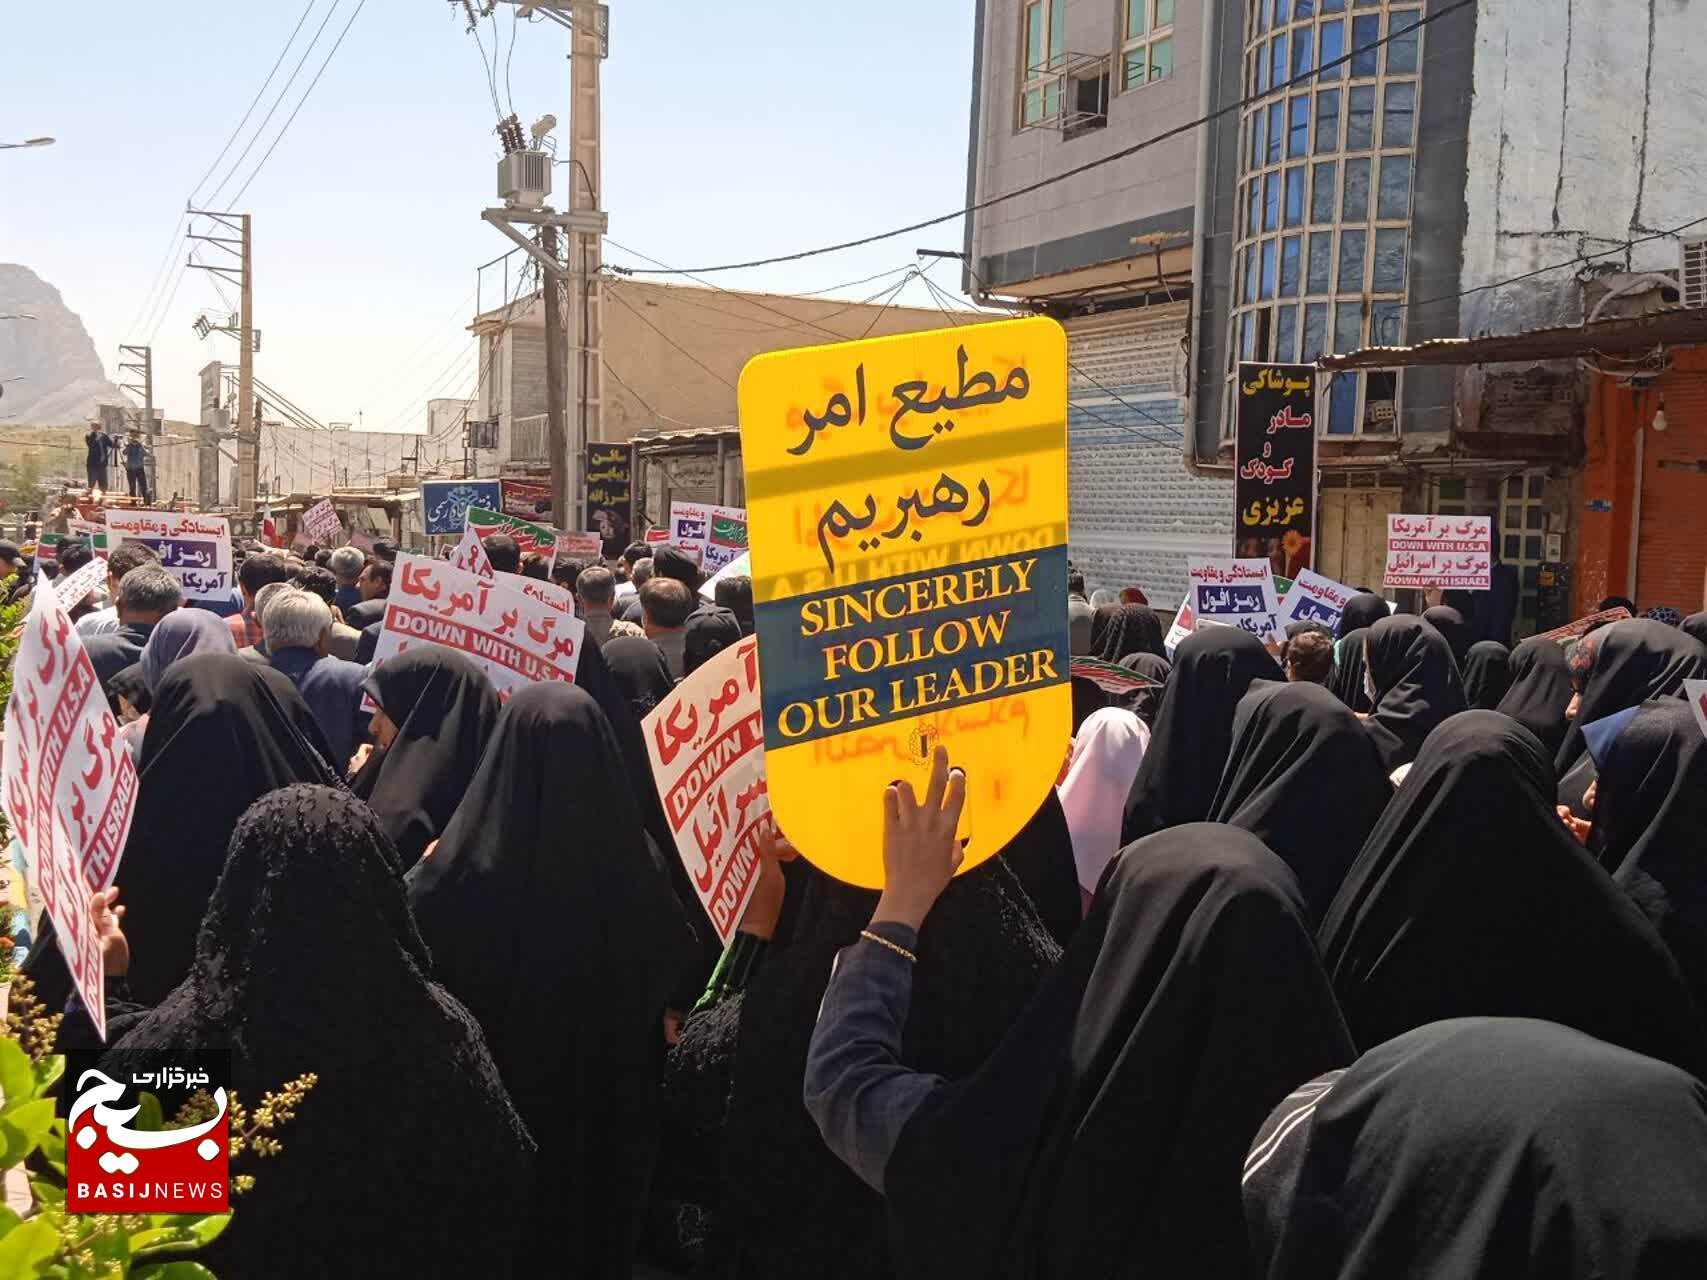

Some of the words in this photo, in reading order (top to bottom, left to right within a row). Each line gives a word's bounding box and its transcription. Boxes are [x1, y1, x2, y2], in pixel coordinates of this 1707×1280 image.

[1242, 368, 1311, 397] پوشاکی
[787, 363, 866, 456] امر
[890, 344, 1030, 450] مطیع
[1267, 405, 1312, 434] مادر
[1263, 441, 1272, 458] و
[1240, 458, 1294, 485] کودک
[817, 472, 990, 574] رهبریم
[1242, 496, 1304, 526] عزیزی
[111, 518, 159, 536] مقاومت
[160, 525, 168, 537] و
[169, 519, 225, 537] ایستادگی
[1392, 516, 1435, 537] آمریکا
[1436, 523, 1450, 538] بر
[1456, 519, 1487, 539] مرگ
[158, 540, 173, 559] اف
[173, 546, 211, 568] رمز
[1392, 540, 1424, 550] DOWN
[1426, 541, 1455, 550] WITH
[1226, 564, 1268, 583] ایستادگی
[1387, 552, 1436, 574] اسرائیل
[1437, 559, 1452, 574] بر
[1456, 555, 1489, 575] مرگ
[401, 562, 495, 617] آمریکا
[1219, 572, 1225, 583] و
[1299, 578, 1339, 603] مقاومت
[1386, 575, 1420, 585] DOWN
[1450, 576, 1486, 586] ISRAEL
[801, 559, 1038, 637] SINCERELY
[1201, 586, 1231, 613] افول
[1231, 592, 1260, 612] رمز
[493, 608, 519, 639] بر
[1299, 605, 1341, 630] افول
[394, 609, 466, 646] DOWN
[472, 632, 521, 667] WITH
[528, 616, 575, 661] مرگ
[822, 610, 1012, 681] FOLLOW
[654, 641, 756, 765] آمریکا
[778, 686, 880, 739] OUR
[890, 649, 1059, 714] LEADER
[672, 729, 743, 818] DOWN
[102, 758, 135, 853] ISRAEL
[712, 836, 756, 930] DOWN
